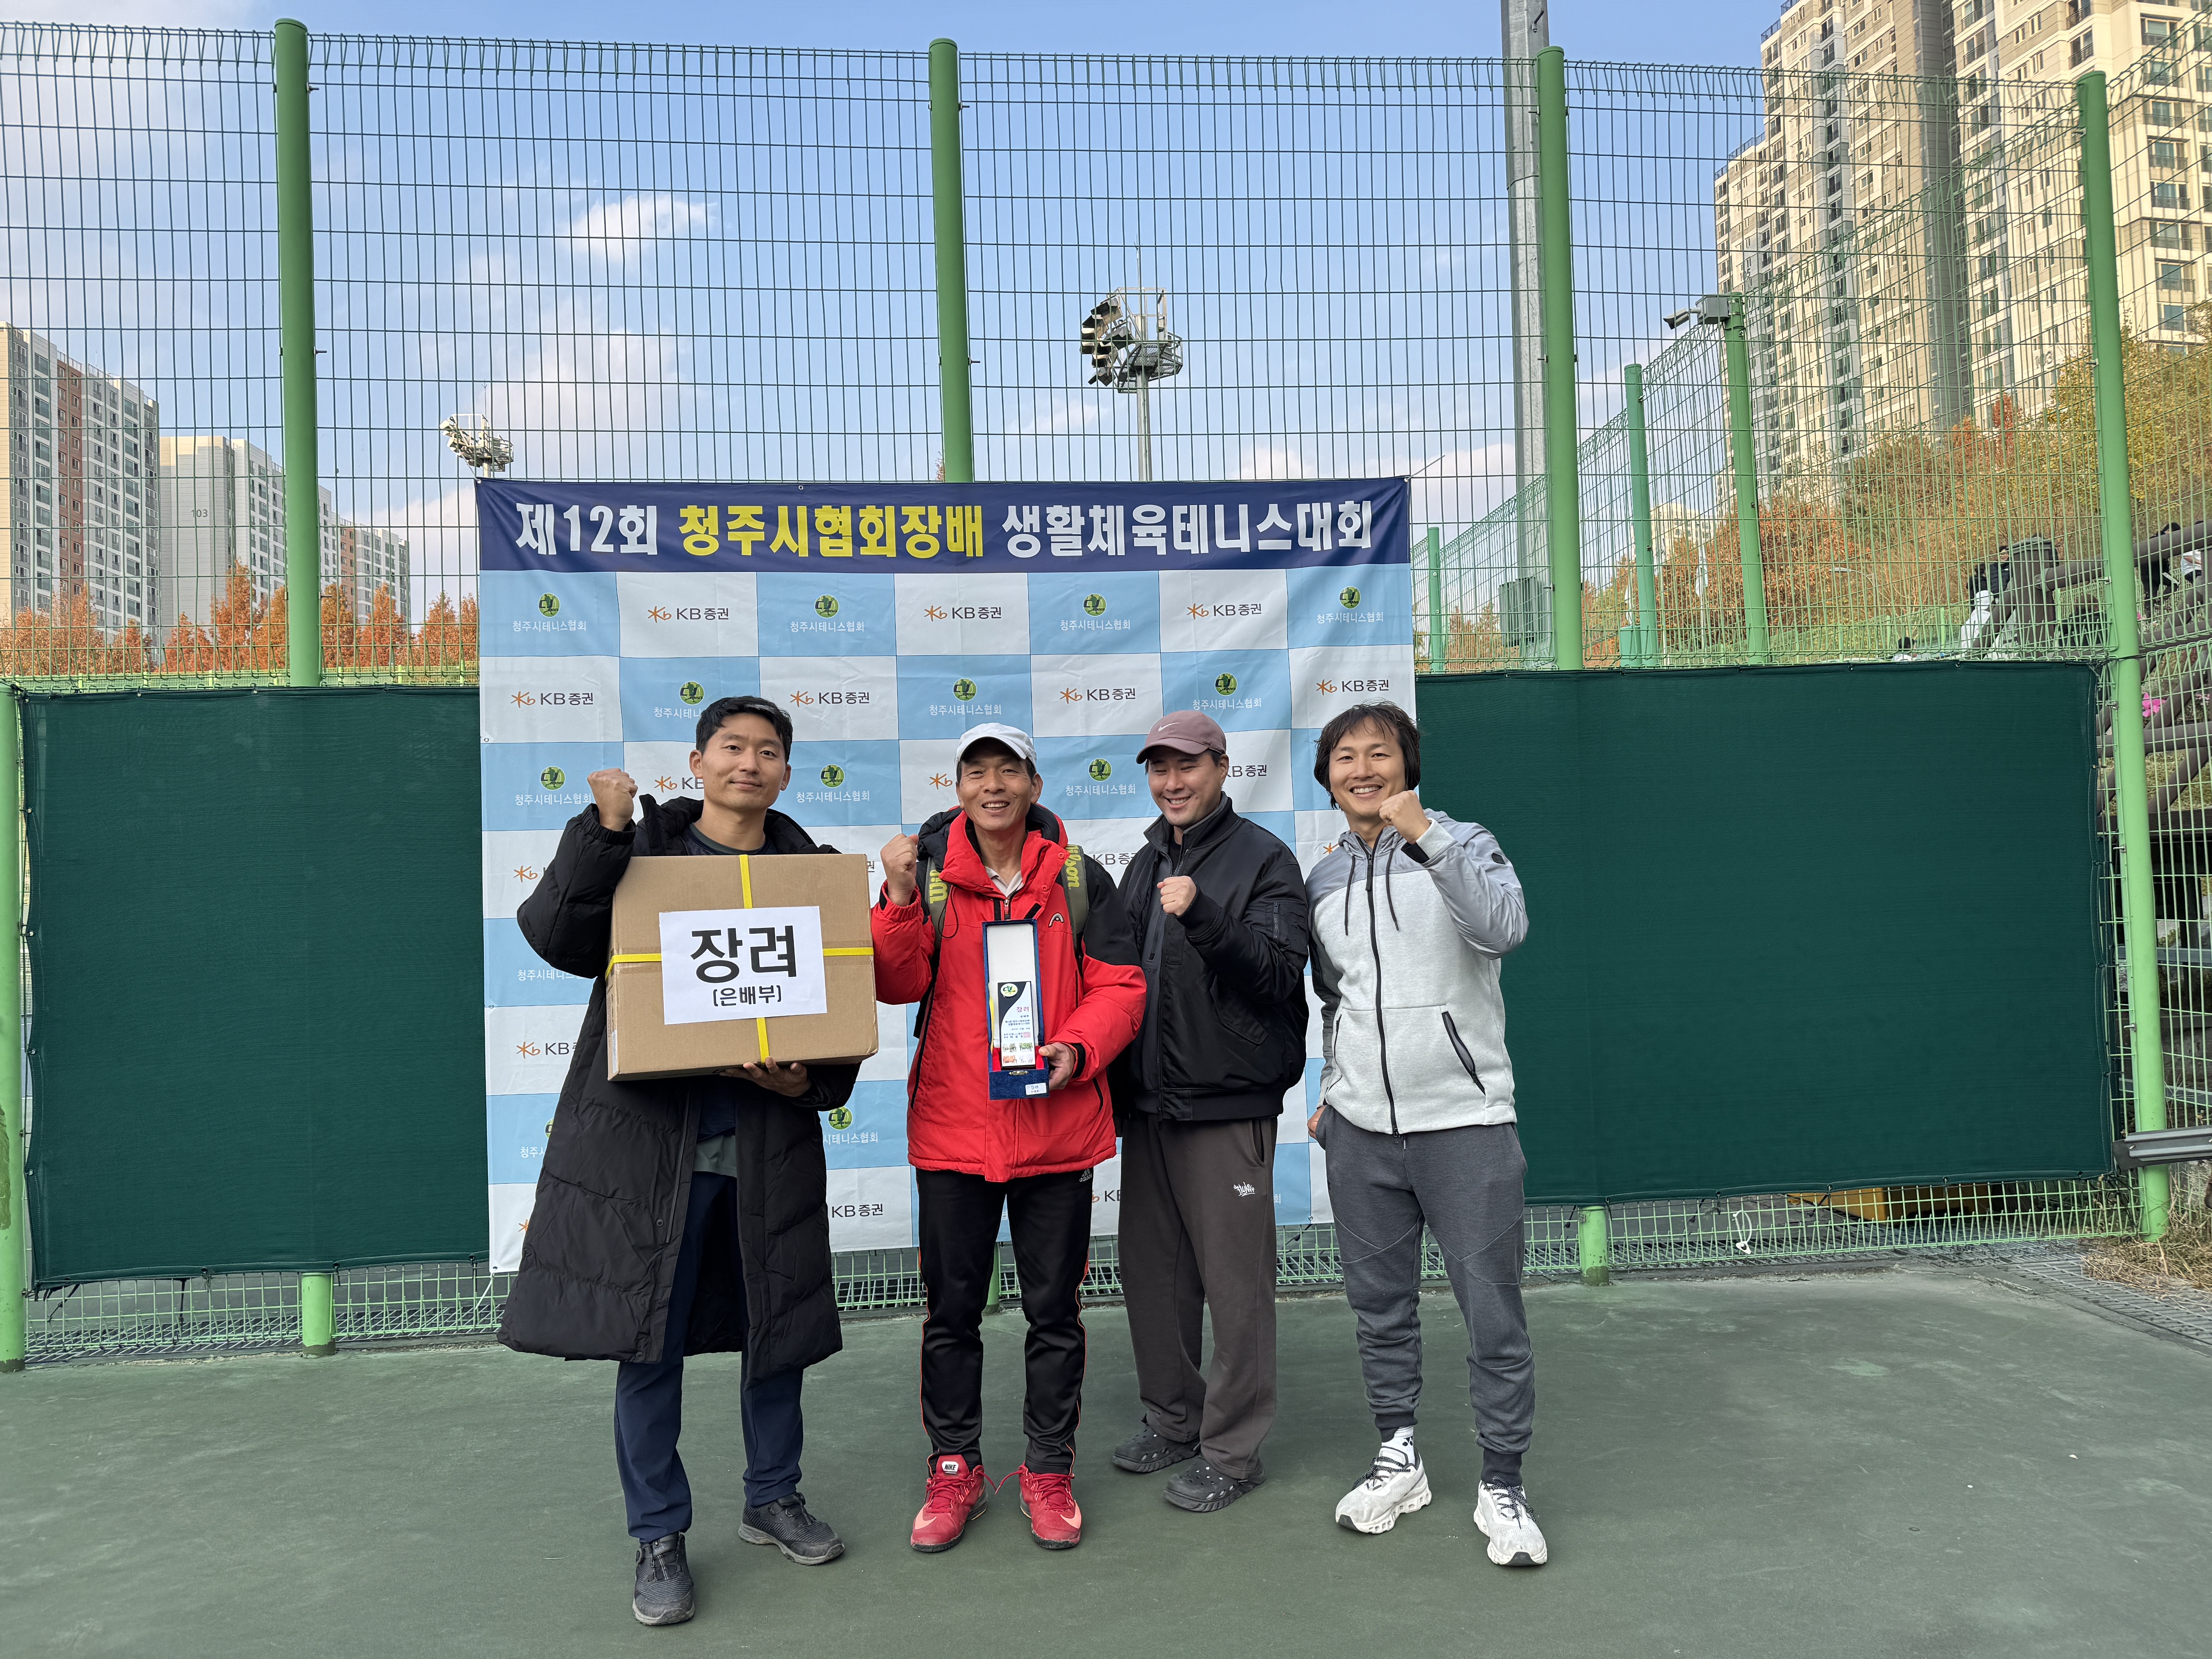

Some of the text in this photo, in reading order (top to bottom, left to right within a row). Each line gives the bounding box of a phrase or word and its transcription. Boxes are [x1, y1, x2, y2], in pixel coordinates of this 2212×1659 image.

[191, 509, 208, 518] 103
[515, 500, 1372, 559] 제12회 청주시협회장배 생활체육테니스대회
[677, 608, 701, 620] KB
[704, 608, 729, 620] 증권
[952, 607, 975, 619] KB
[977, 606, 1001, 619] 증권
[1213, 605, 1236, 617] KB
[1238, 603, 1262, 616] 증권
[1316, 611, 1383, 624] 청주시테니스협회
[512, 620, 586, 632] 청주시테니스협회
[790, 621, 864, 632] 청주시테니스협회
[1060, 619, 1130, 631] 청주시테니스협회
[1341, 680, 1364, 692] KB
[1366, 679, 1389, 692] 증권
[540, 693, 565, 705] KB
[568, 692, 593, 706] 증권
[819, 692, 843, 704] KB
[845, 692, 870, 704] 증권
[1087, 689, 1110, 701] KB
[1112, 688, 1136, 700] 증권
[929, 704, 1001, 716] 청주시테니스협회
[1192, 697, 1261, 710] 청주시테니스협회
[653, 707, 701, 719] 청주시테니
[1227, 764, 1267, 777] B 증권
[1065, 783, 1135, 796] 청주시테니스협회
[515, 793, 592, 806] 청주시테니스협회
[796, 790, 870, 803] 청주시테니스협회
[1093, 854, 1116, 865] KB
[690, 925, 797, 983] 장려
[713, 985, 781, 1007] (은배부)
[545, 1042, 569, 1055] KB
[831, 1203, 883, 1218] KB 증권
